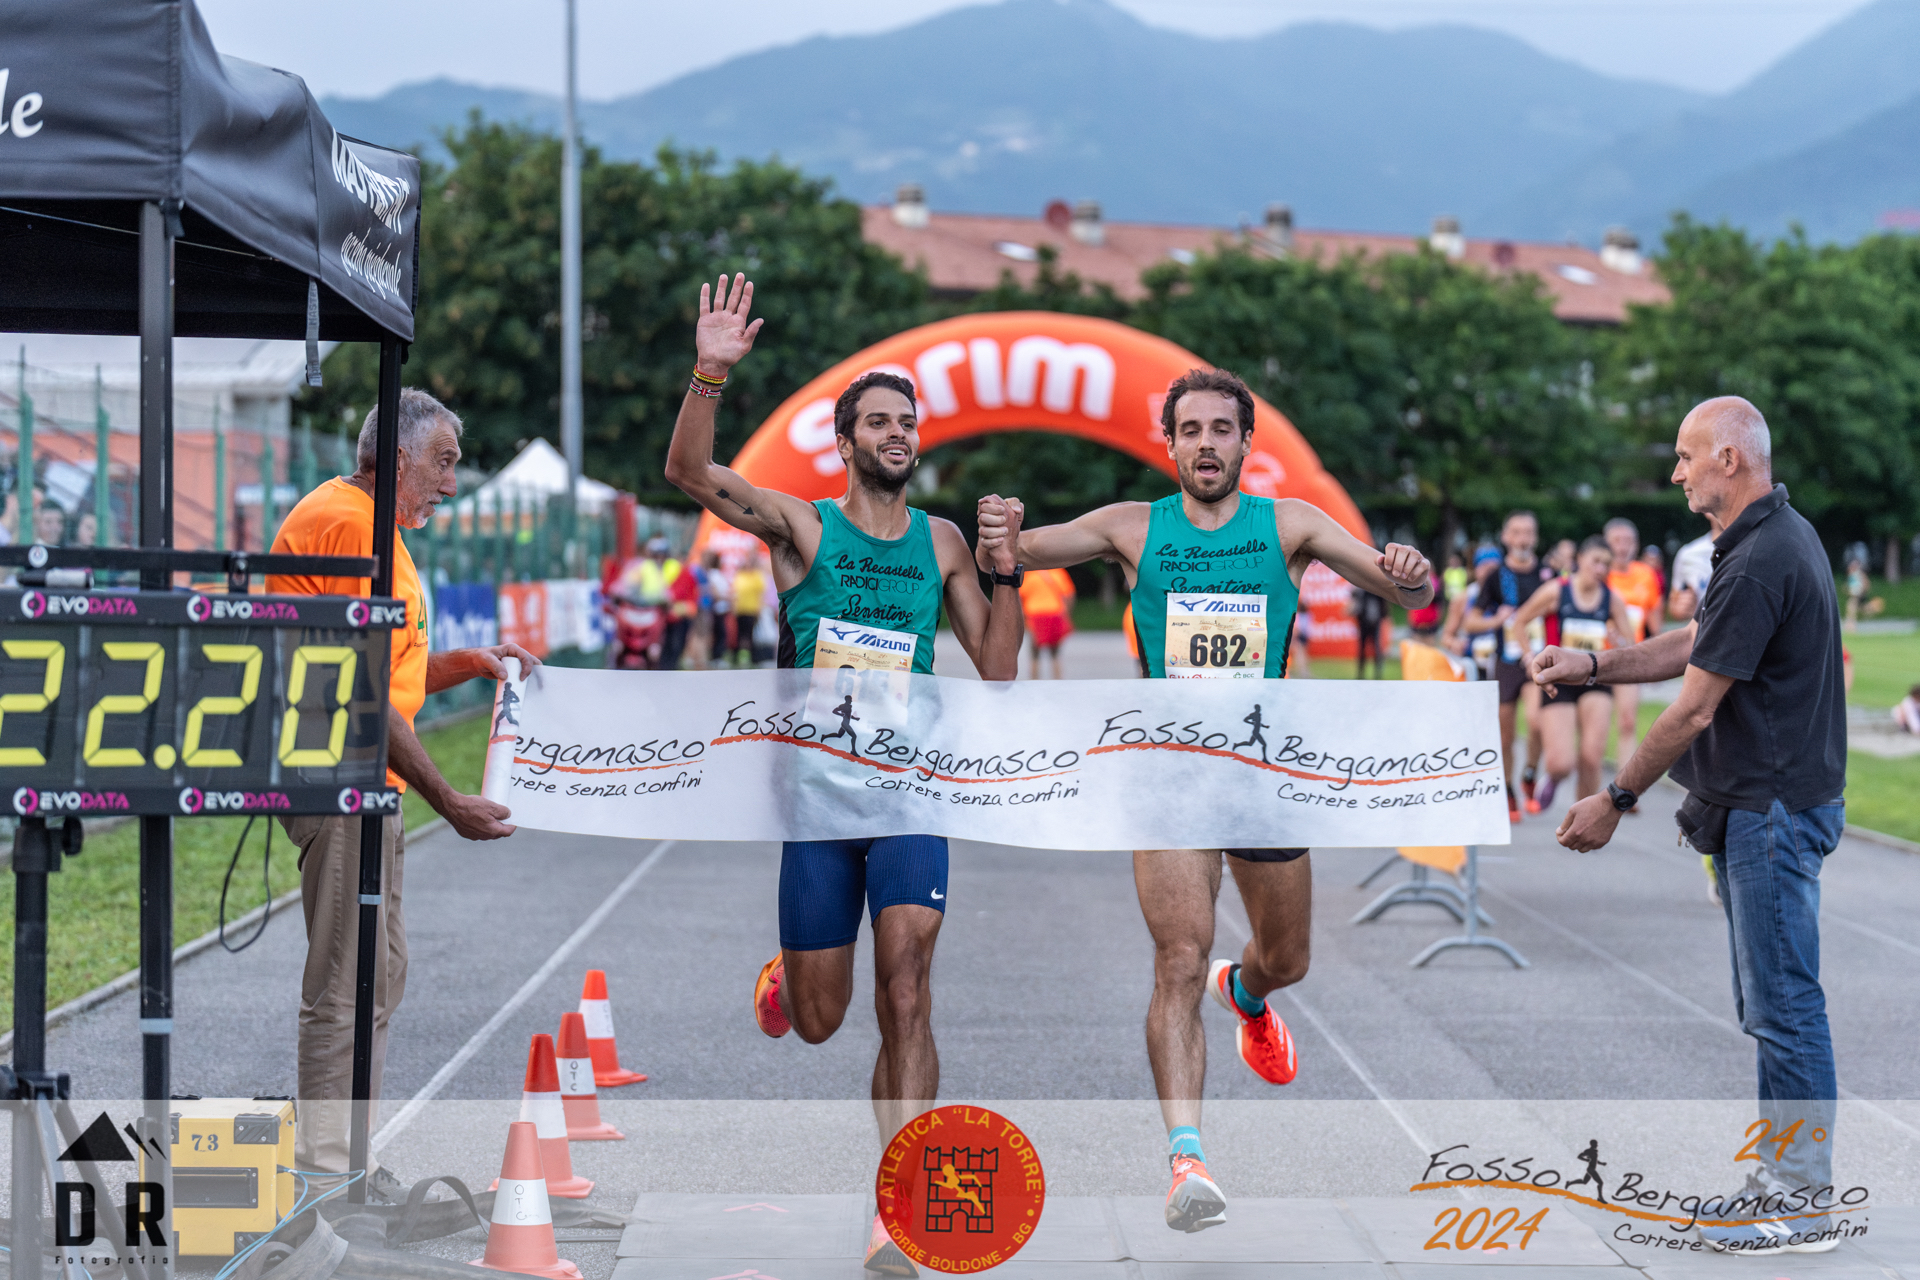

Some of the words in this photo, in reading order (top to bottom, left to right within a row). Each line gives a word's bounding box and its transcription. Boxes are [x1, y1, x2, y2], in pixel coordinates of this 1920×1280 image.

[786, 334, 1119, 477] srim
[1155, 543, 1179, 558] La
[834, 554, 855, 570] La
[1159, 556, 1264, 573] RADICIGROUP
[840, 574, 920, 595] RADICIGROUP
[1163, 576, 1263, 600] Sensitive
[47, 595, 138, 616] EVODATA
[212, 600, 299, 620] EVODATA
[841, 593, 914, 623] Sensitive
[1203, 600, 1261, 613] MIZUNO
[853, 632, 911, 653] MIZUNO
[1189, 633, 1247, 667] 682
[720, 700, 817, 740] Fosso
[864, 728, 1080, 782] Bergamasco
[1098, 708, 1229, 749] Fosso
[1274, 735, 1498, 791] Bergamasco
[566, 782, 627, 797] senza
[633, 769, 703, 795] confini
[950, 791, 1003, 806] senza
[1008, 780, 1080, 805] confini
[1277, 782, 1358, 809] Correre
[1367, 792, 1427, 809] senza
[1432, 777, 1501, 803] confini
[39, 790, 130, 810] EVODATA
[204, 791, 291, 810] EVODATA
[570, 1060, 578, 1092] OTC
[191, 1134, 219, 1151] 73
